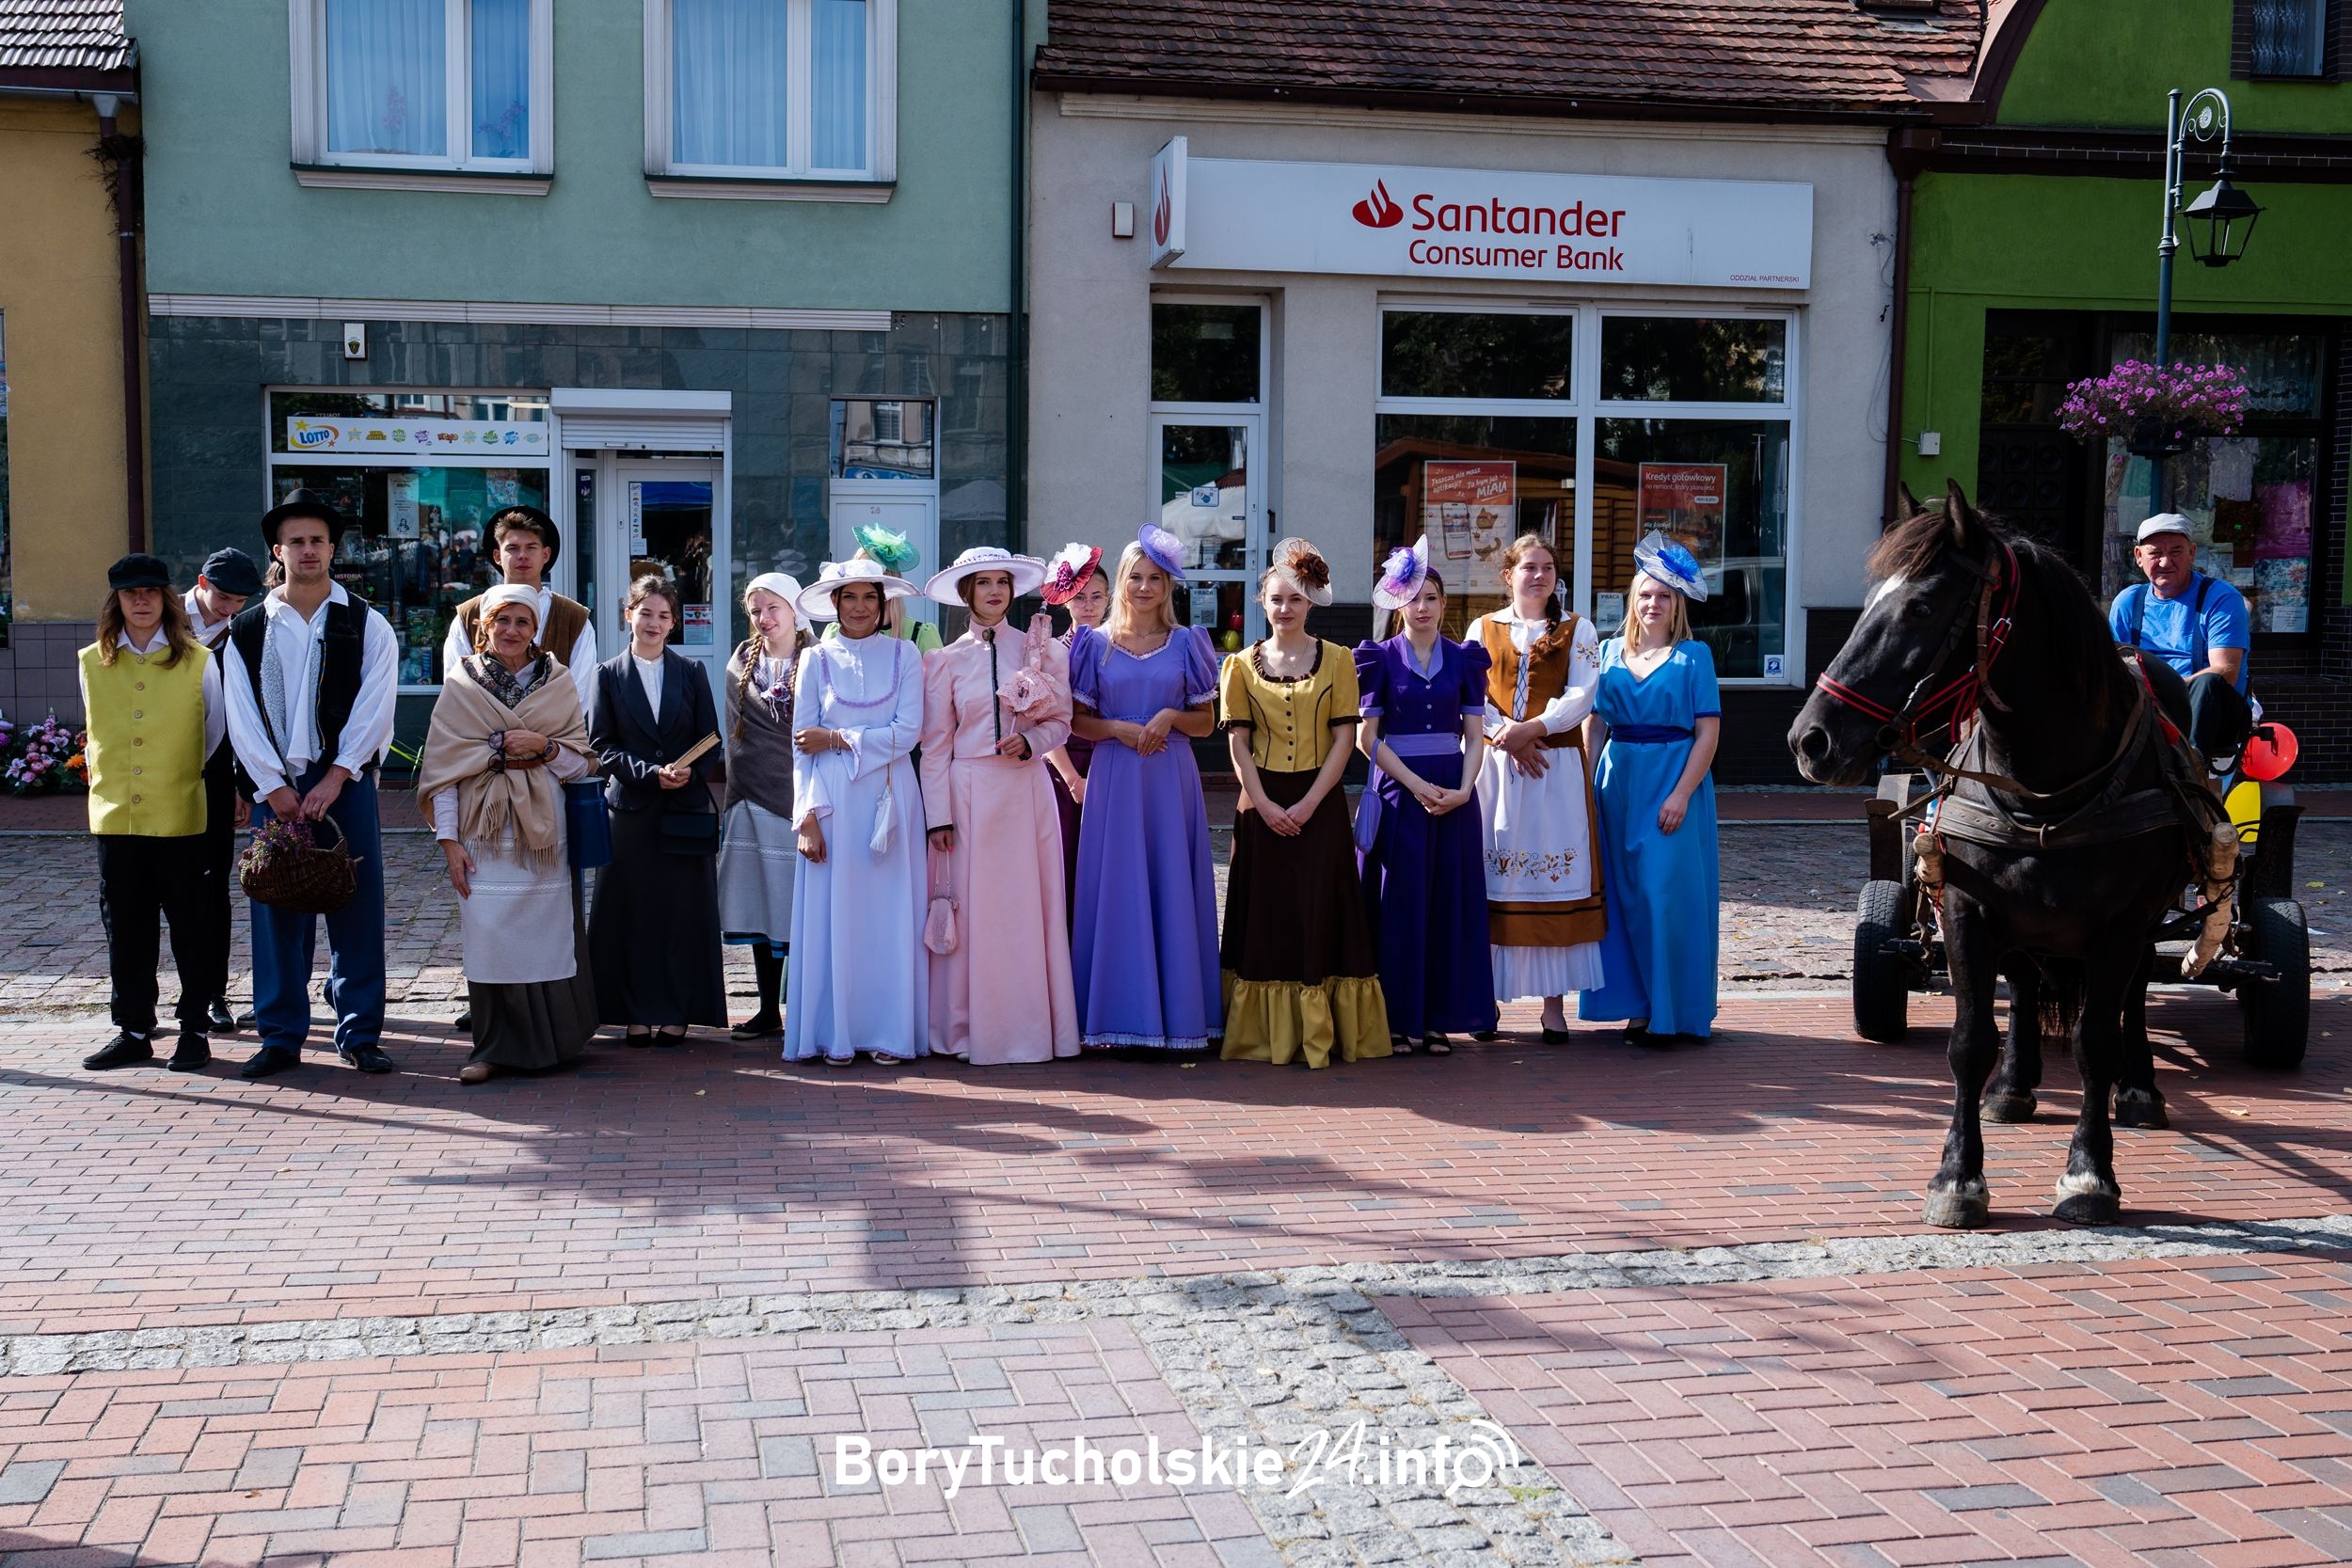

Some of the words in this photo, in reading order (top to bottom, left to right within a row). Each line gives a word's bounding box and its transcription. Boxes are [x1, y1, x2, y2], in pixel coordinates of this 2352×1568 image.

[1412, 194, 1626, 237] Santander
[1409, 239, 1548, 267] Consumer
[1557, 245, 1624, 271] Bank
[299, 429, 330, 445] LOTTO
[1466, 467, 1481, 476] masz
[1645, 472, 1671, 483] Kredyt
[1672, 473, 1716, 483] gotówkowy
[1433, 480, 1462, 495] aplikacji?
